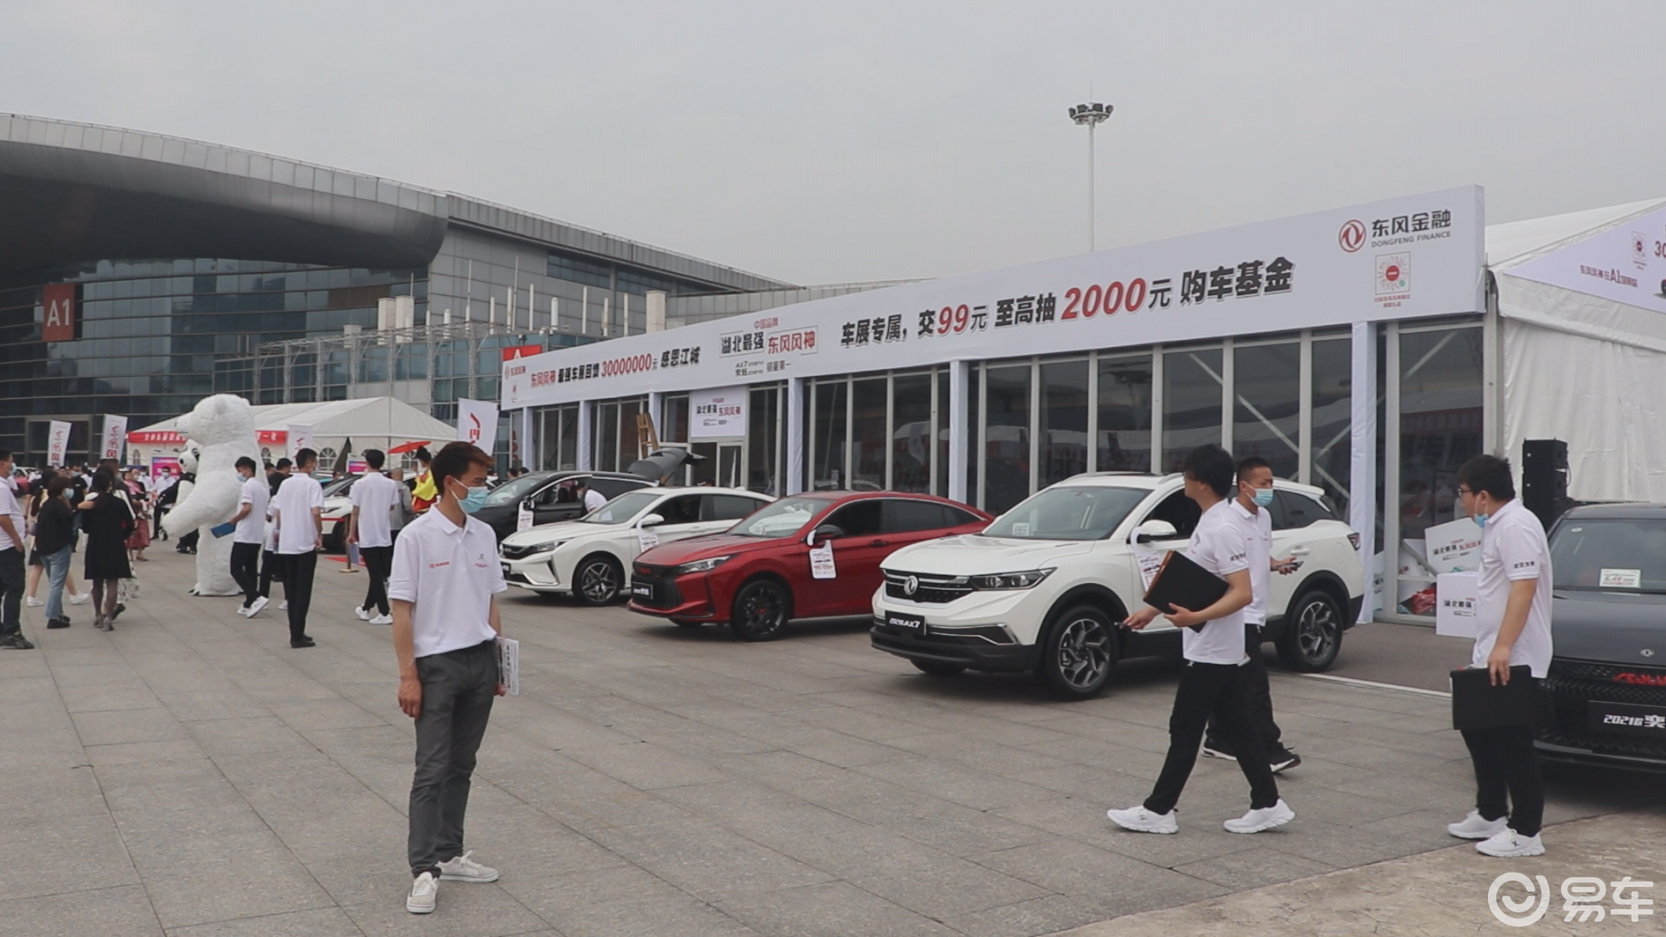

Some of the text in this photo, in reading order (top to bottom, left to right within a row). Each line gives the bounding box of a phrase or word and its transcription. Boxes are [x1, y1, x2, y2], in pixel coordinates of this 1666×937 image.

[1371, 209, 1452, 238] 东风金融
[1371, 230, 1451, 248] DONGFENG FINANCE
[1181, 255, 1294, 304] 购车基金
[47, 298, 70, 327] A1
[721, 330, 816, 355] 湖北最强 东风风神
